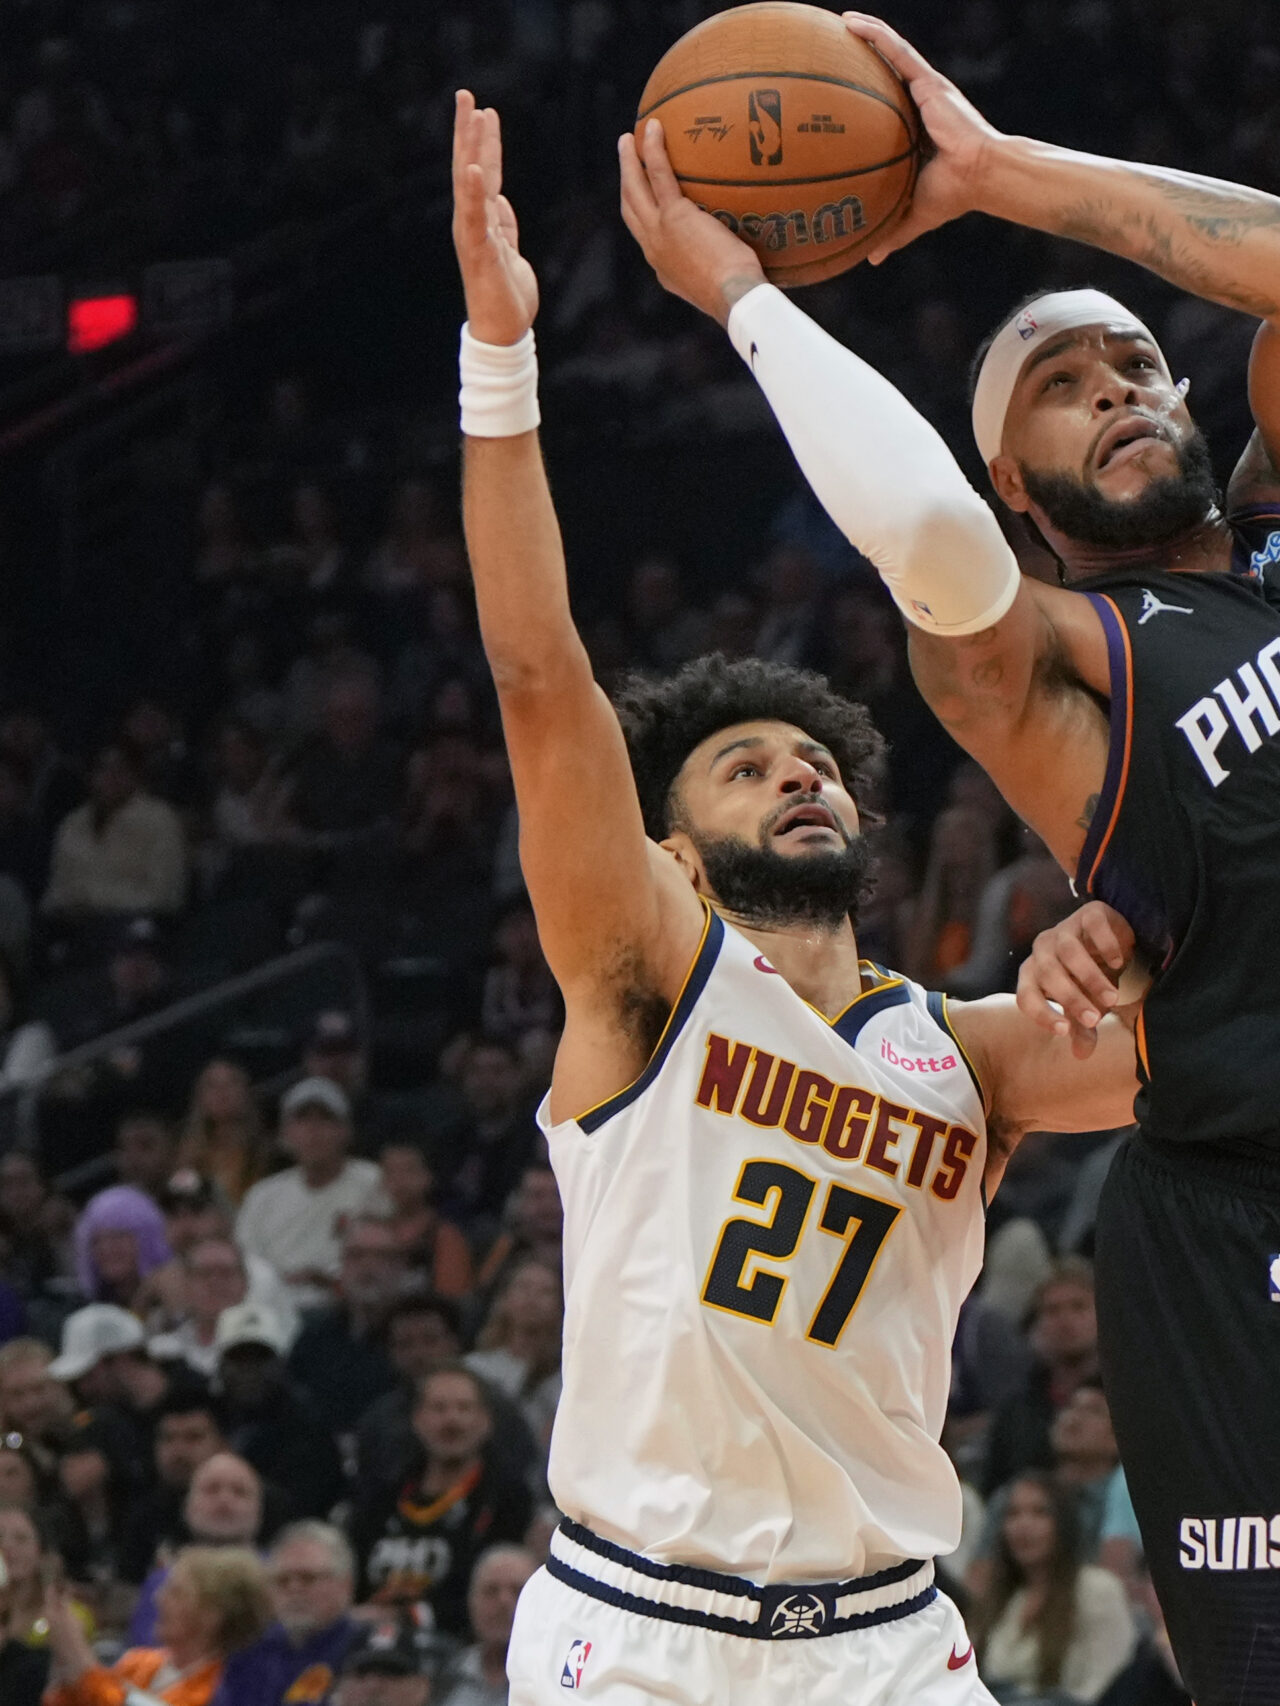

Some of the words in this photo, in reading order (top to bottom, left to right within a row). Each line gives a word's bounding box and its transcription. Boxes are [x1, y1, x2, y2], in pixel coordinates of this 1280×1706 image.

[695, 195, 867, 252] Wilso
[881, 1037, 957, 1073] ibotta
[695, 1031, 979, 1201] NUGGETS
[700, 1157, 905, 1350] 27
